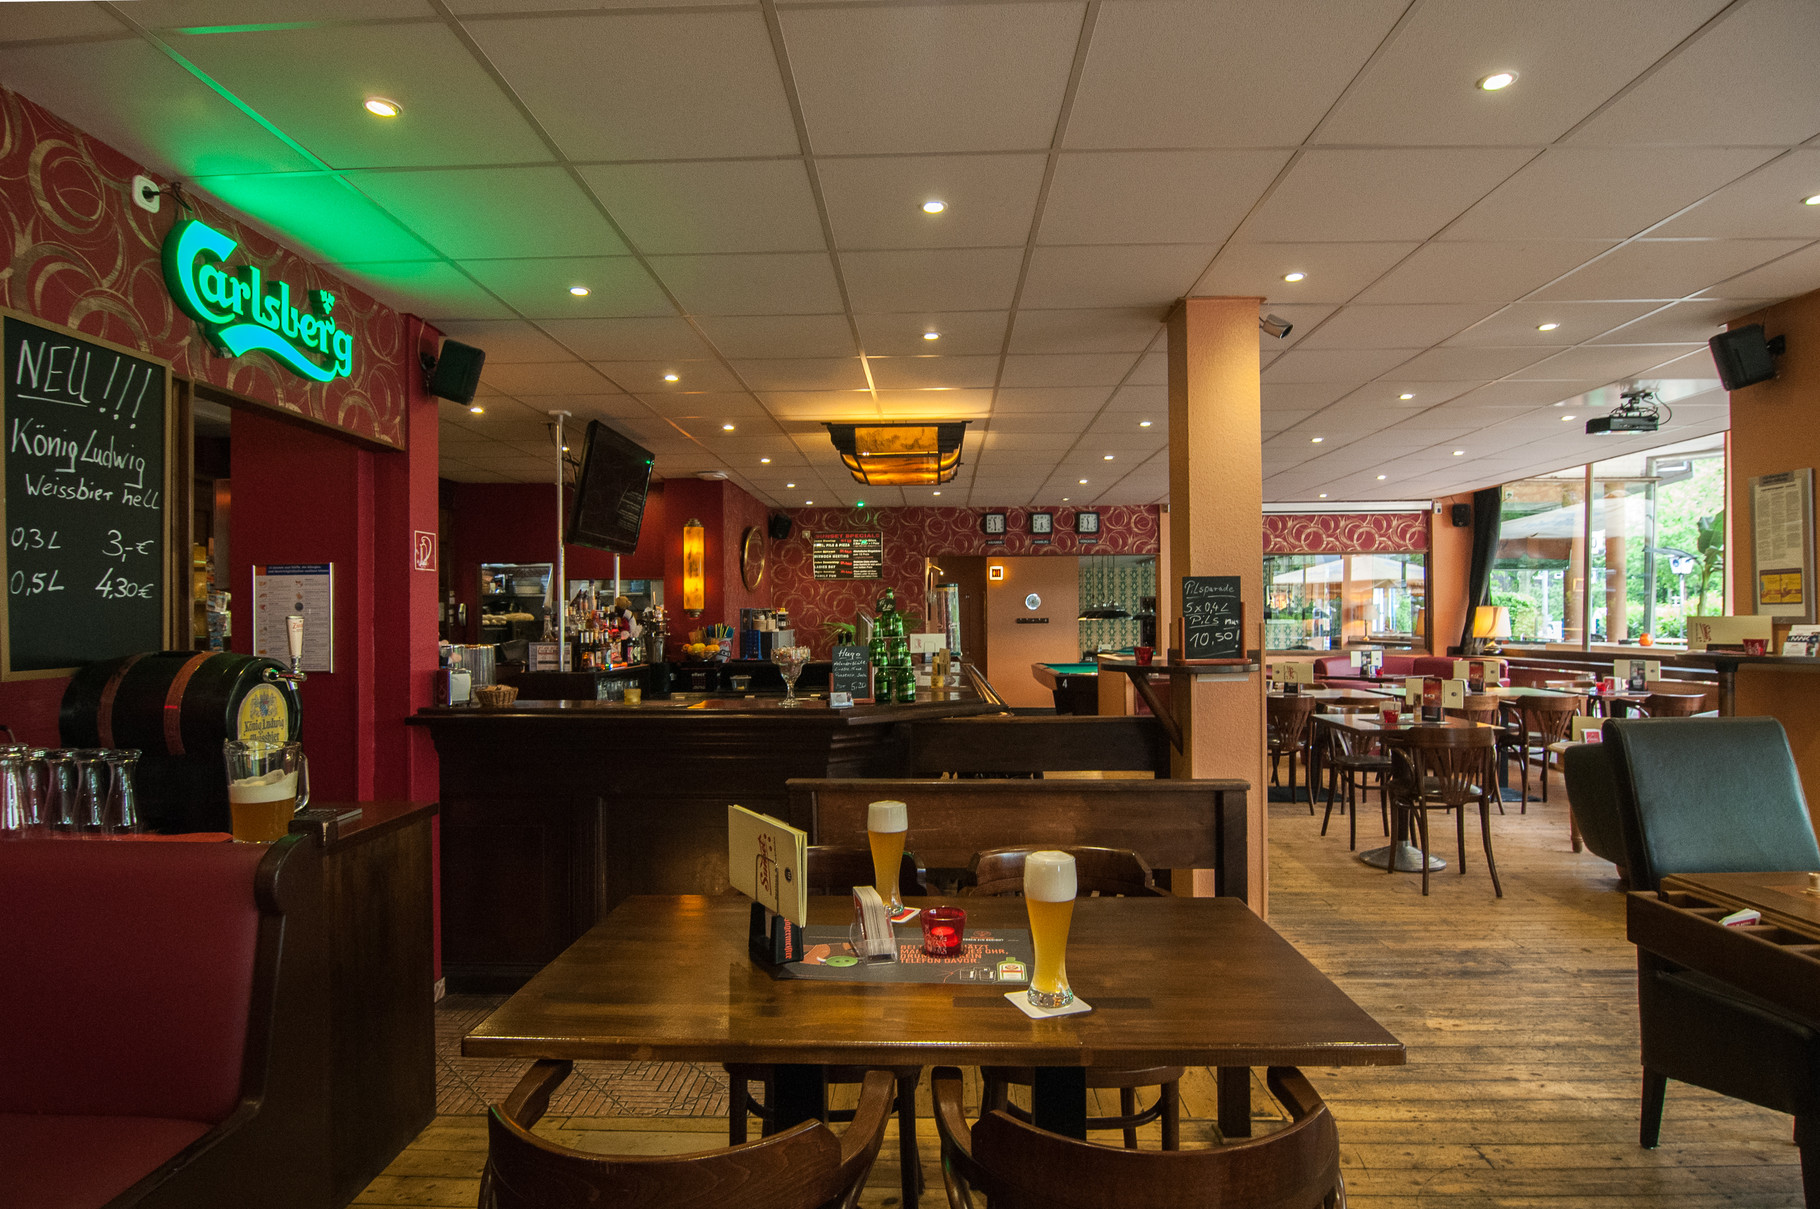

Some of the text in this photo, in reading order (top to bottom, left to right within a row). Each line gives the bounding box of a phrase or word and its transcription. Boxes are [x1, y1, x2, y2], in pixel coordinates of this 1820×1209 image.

[175, 220, 353, 378] Carlsberg
[12, 417, 145, 489] König Ludwig
[25, 473, 160, 510] Weissbier hell
[838, 648, 861, 660] Hugo
